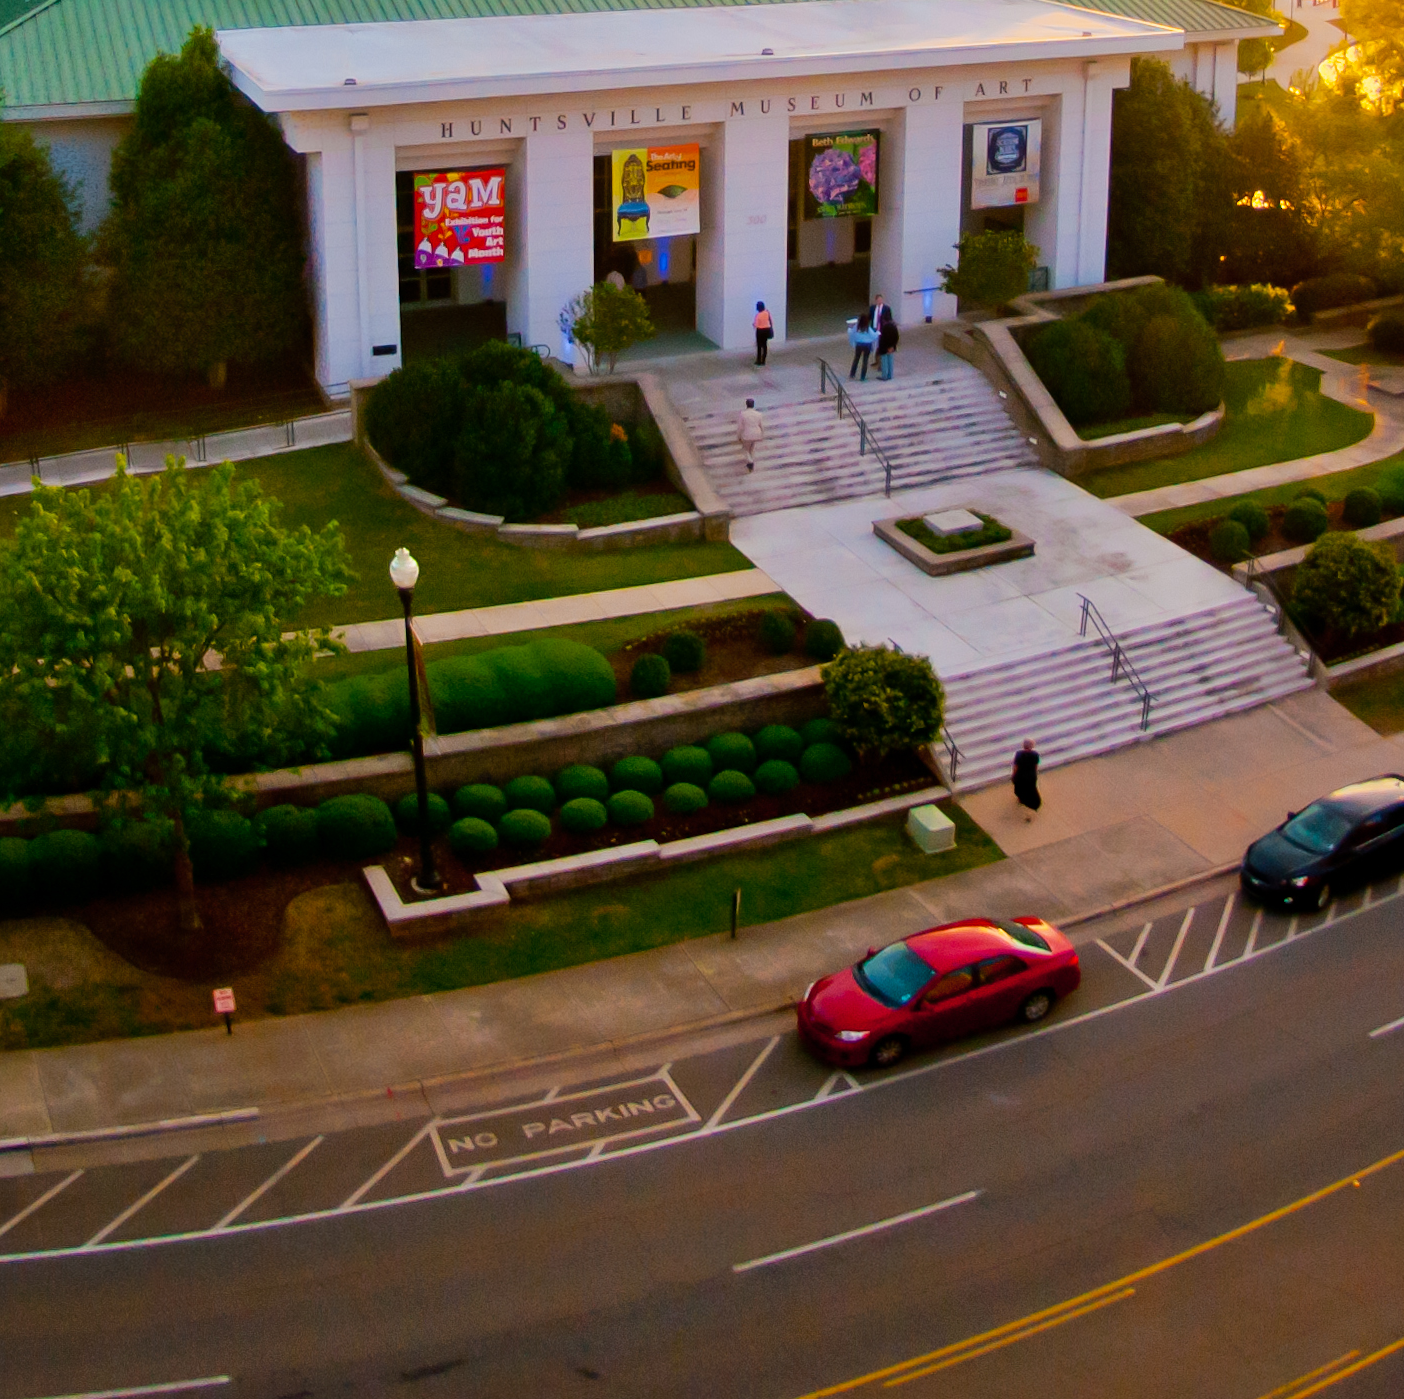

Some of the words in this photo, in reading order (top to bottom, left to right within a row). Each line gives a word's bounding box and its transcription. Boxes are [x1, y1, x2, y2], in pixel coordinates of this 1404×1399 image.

[441, 105, 692, 138] HUNTSVILLE
[730, 91, 874, 117] MUSEUM
[908, 85, 944, 102] OF
[974, 78, 1032, 97] ART
[812, 136, 834, 148] Beth
[835, 133, 875, 145] Edwards
[646, 159, 696, 172] Seating
[445, 216, 489, 227] Exhibition
[490, 214, 504, 223] for
[471, 226, 504, 238] Youth
[485, 237, 504, 247] Art
[468, 246, 504, 259] Month
[448, 1132, 498, 1155] NO
[521, 1094, 676, 1139] PARKING
